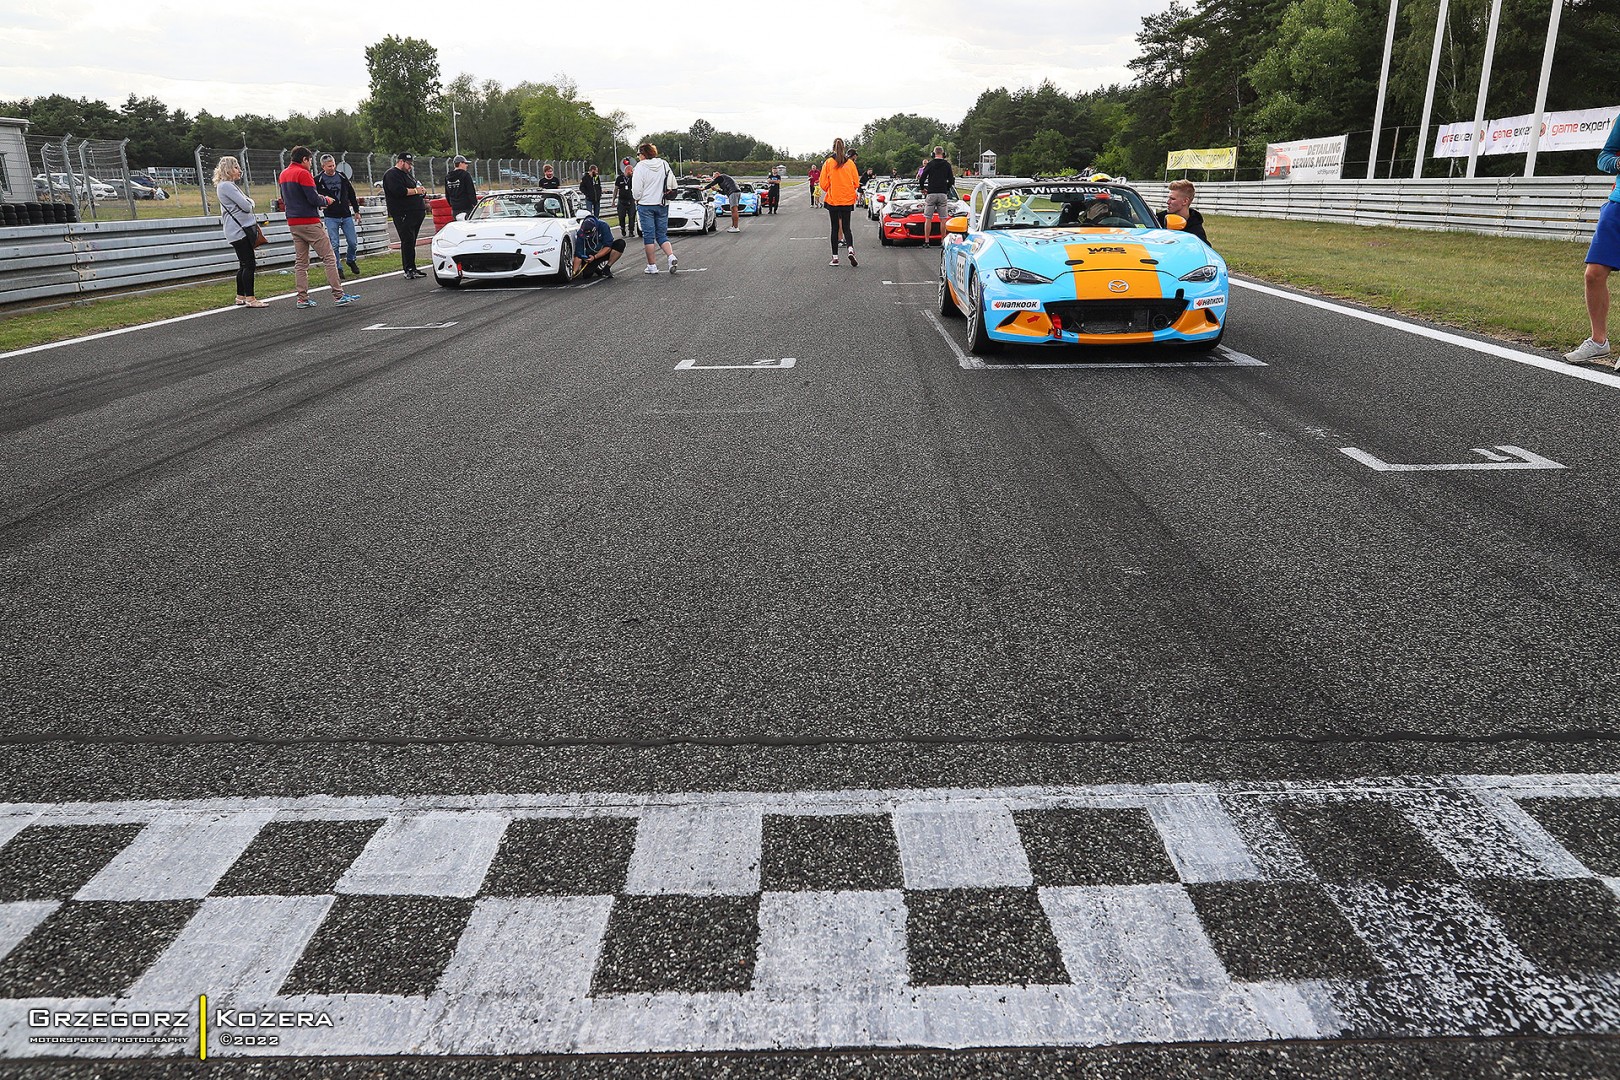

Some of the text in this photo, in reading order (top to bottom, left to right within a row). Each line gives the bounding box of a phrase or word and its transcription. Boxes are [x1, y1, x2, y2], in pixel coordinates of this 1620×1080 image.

[1552, 117, 1611, 137] game expert
[992, 195, 1021, 210] 333
